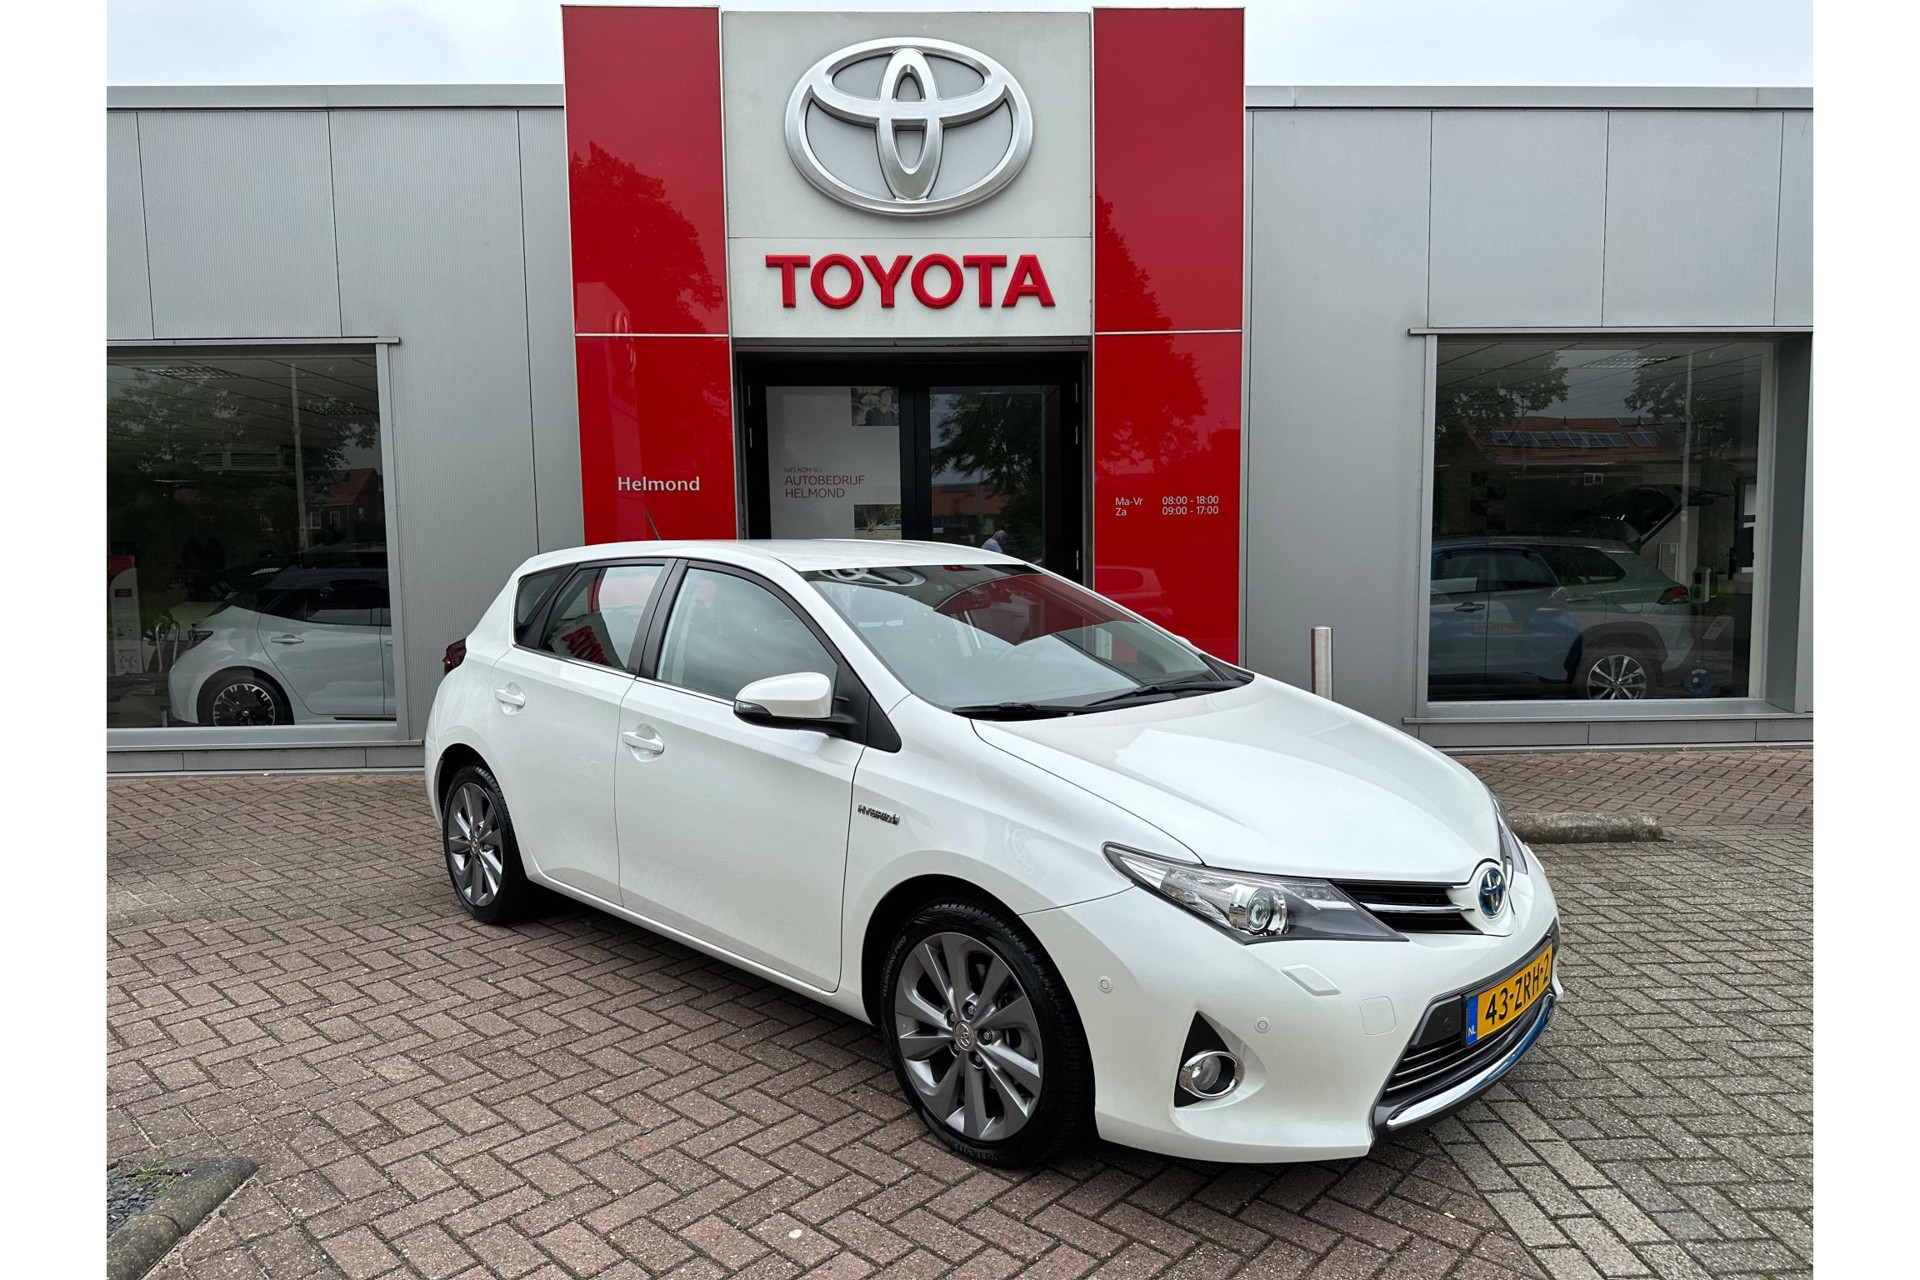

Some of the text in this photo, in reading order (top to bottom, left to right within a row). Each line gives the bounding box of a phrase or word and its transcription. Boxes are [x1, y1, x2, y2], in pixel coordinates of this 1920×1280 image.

[765, 254, 1056, 309] TOYOTA
[617, 476, 700, 492] Helmond
[784, 475, 866, 486] AUTOBEDRIJF
[785, 488, 845, 499] HELMOND
[1115, 497, 1144, 506] Ma-Vr
[1162, 496, 1188, 505] 08:00
[1196, 496, 1219, 504] 18:00
[1115, 508, 1127, 516] Za
[1162, 506, 1188, 515] 09:00
[1196, 506, 1219, 515] 17:00
[1485, 953, 1549, 1025] 43-ZRH-2
[1468, 1025, 1477, 1037] NL
